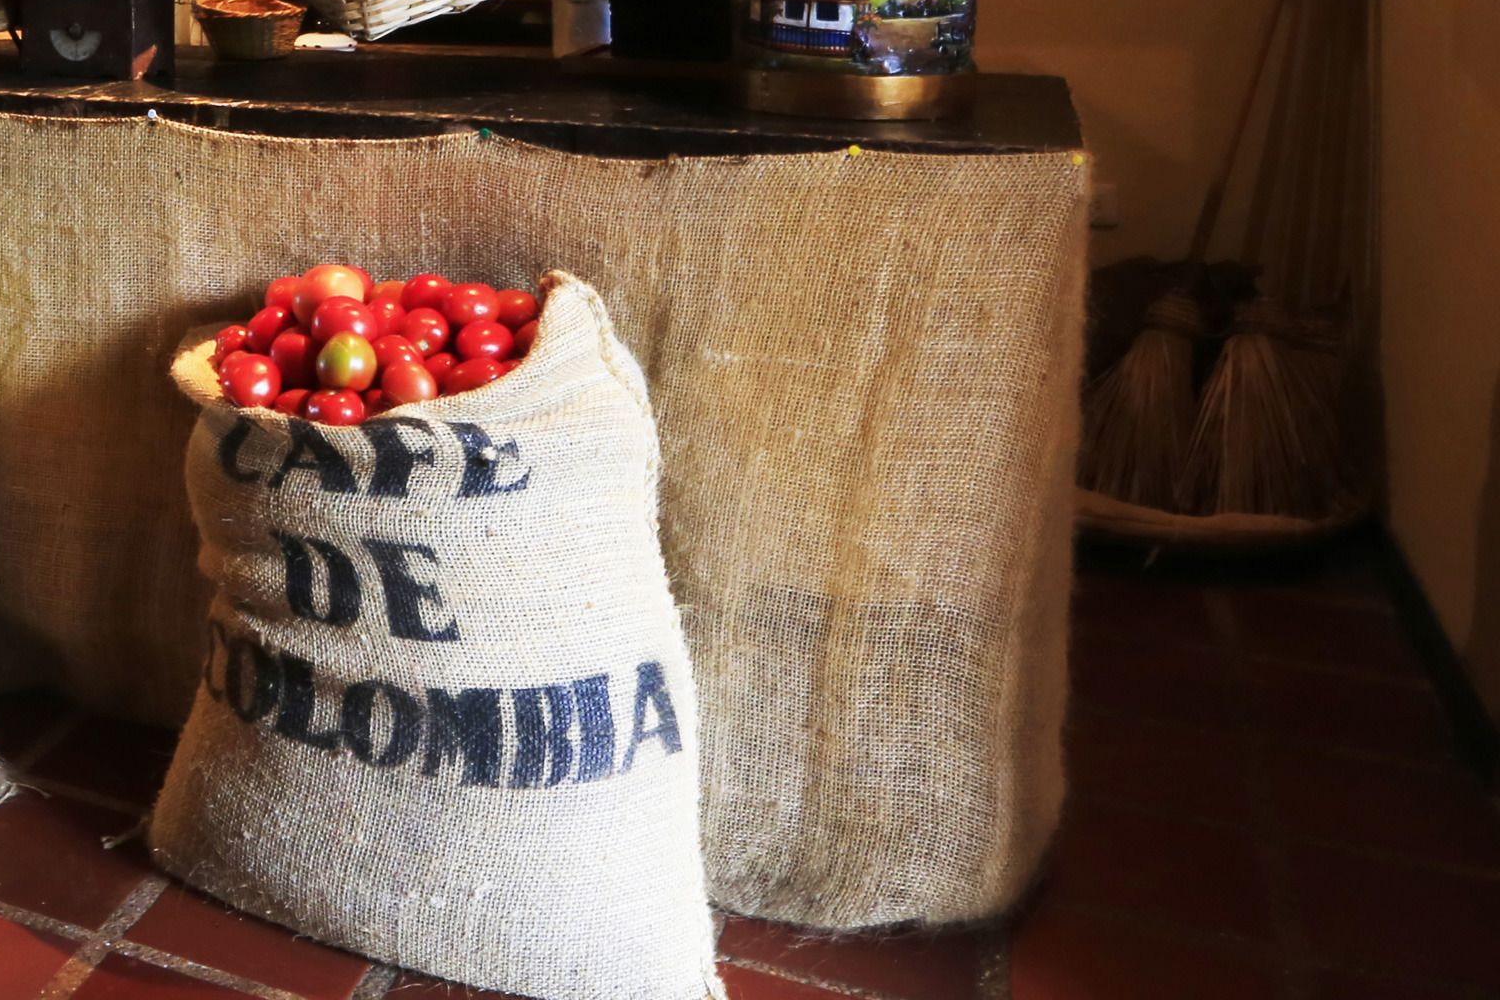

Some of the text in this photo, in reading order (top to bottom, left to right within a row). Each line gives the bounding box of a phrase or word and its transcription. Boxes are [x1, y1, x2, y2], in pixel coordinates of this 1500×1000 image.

[219, 415, 532, 499] CAFE
[270, 528, 461, 643] DE
[204, 619, 683, 790] COLOMBIA
